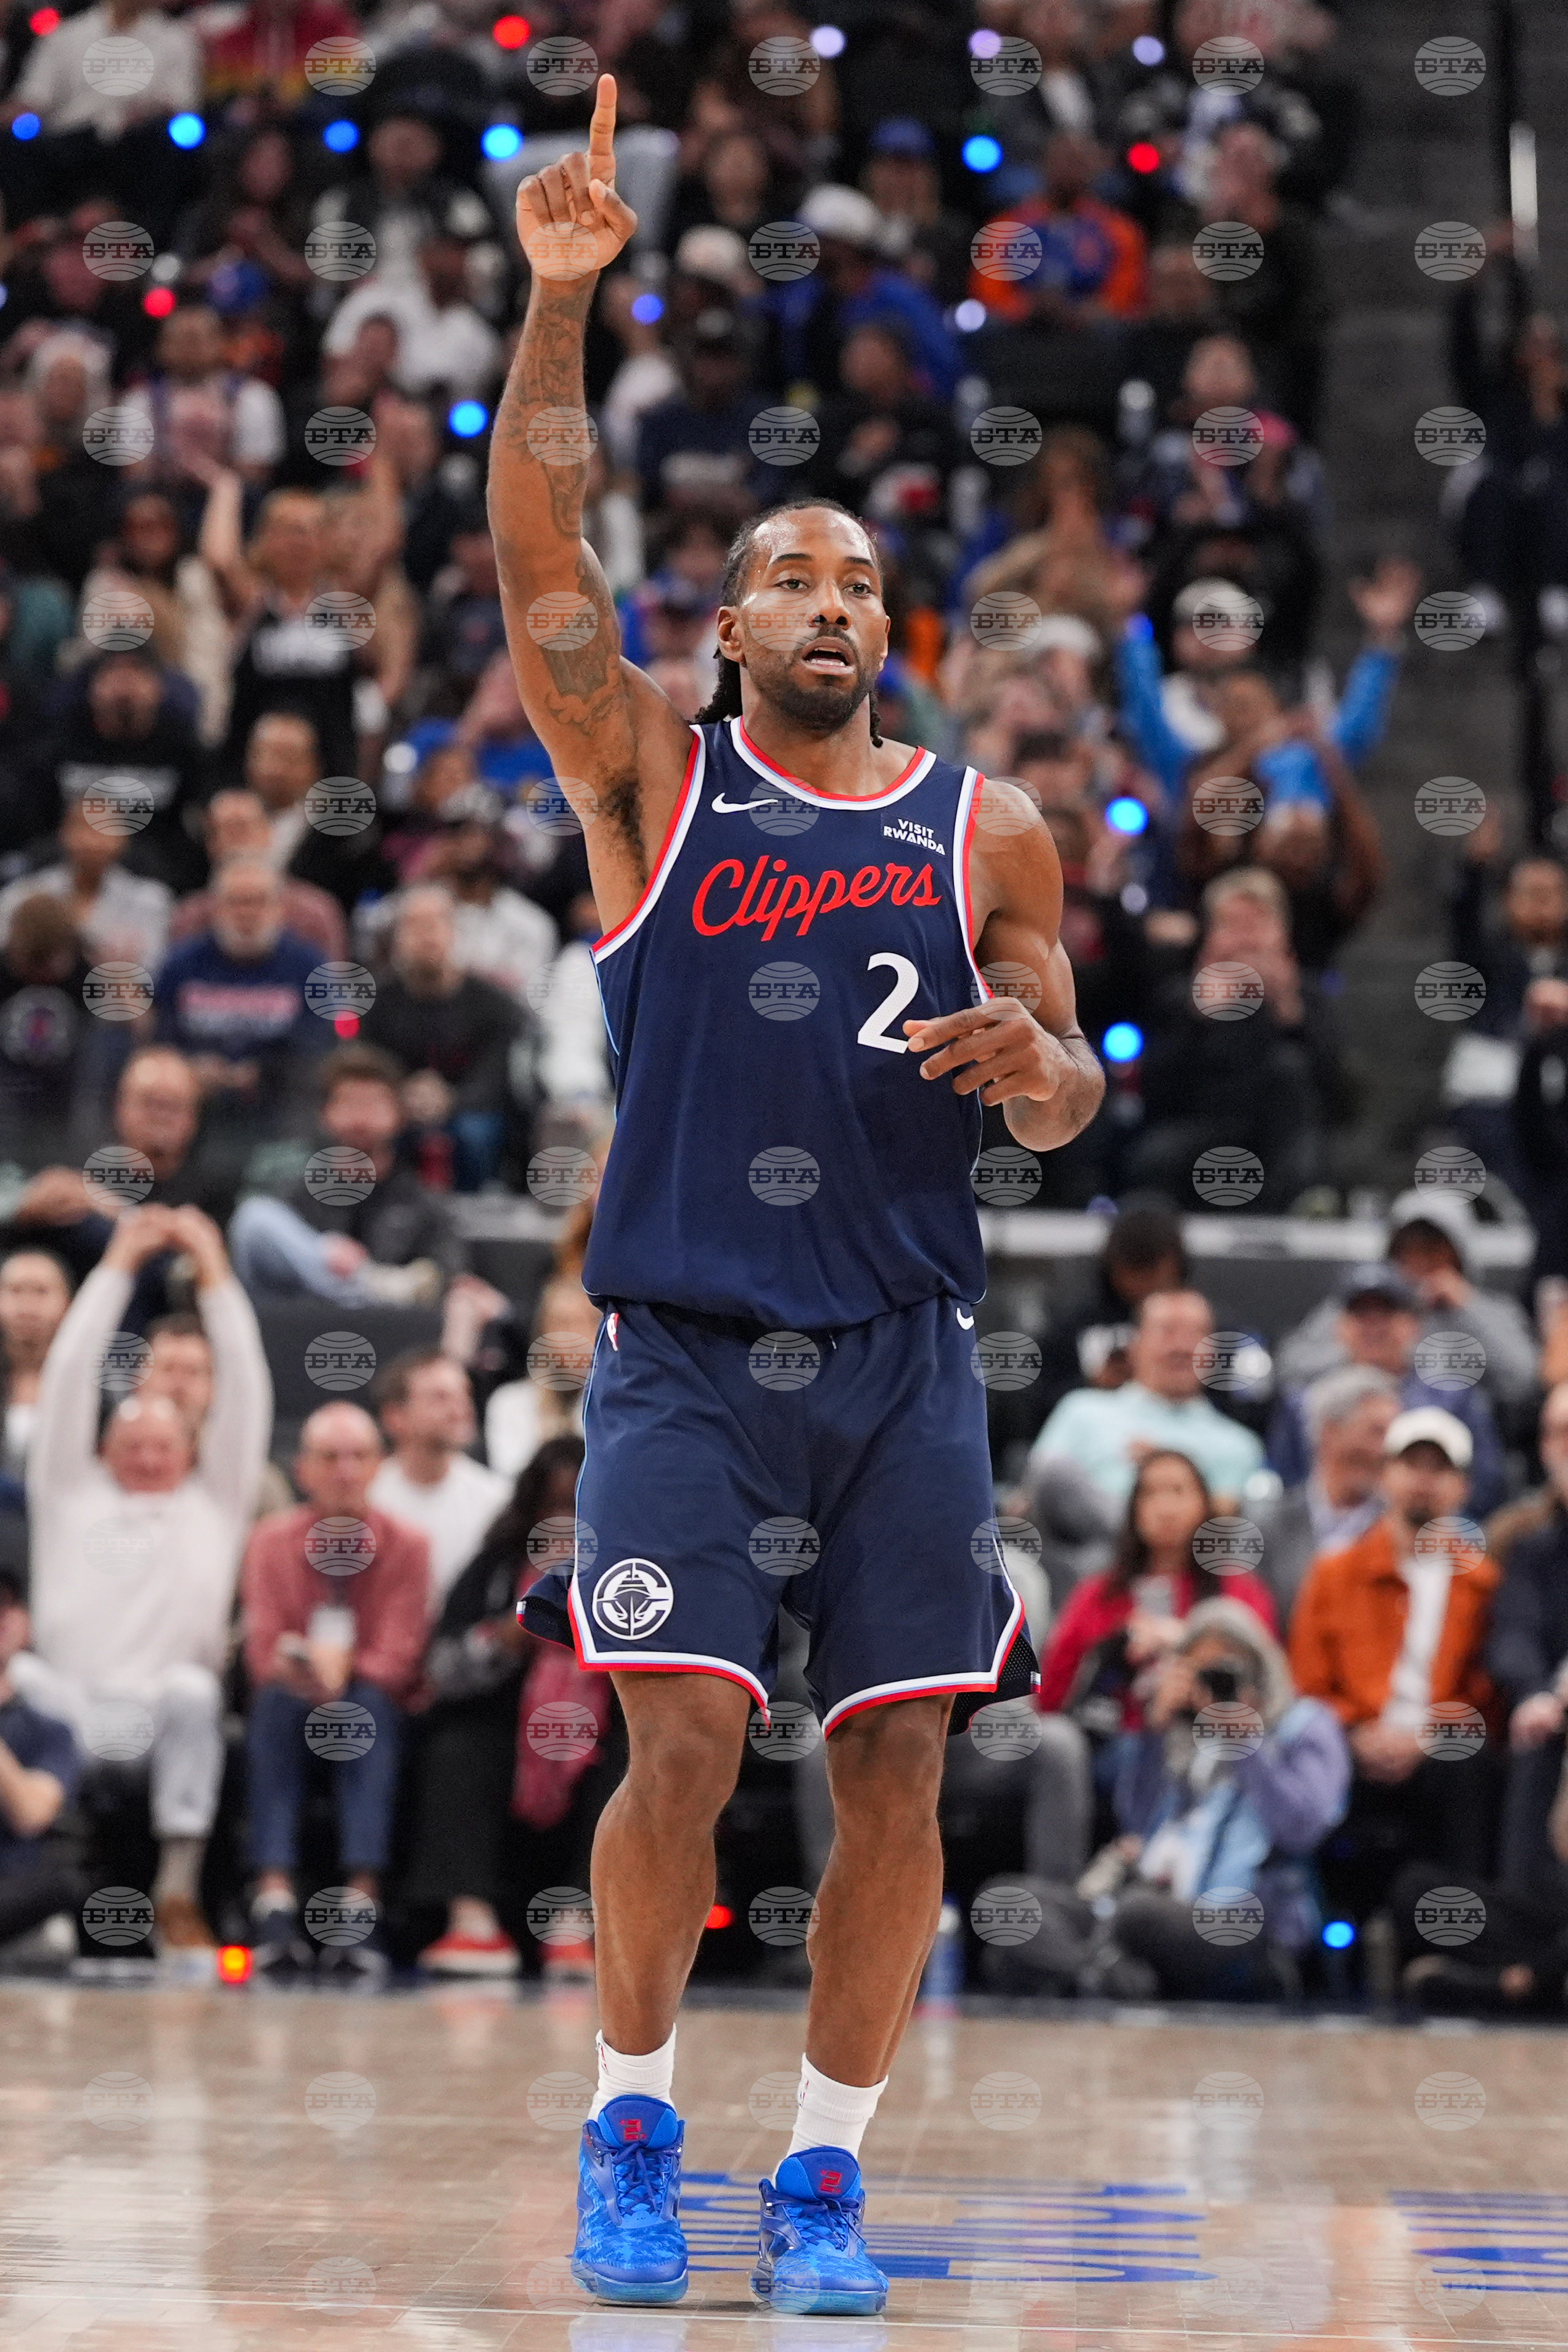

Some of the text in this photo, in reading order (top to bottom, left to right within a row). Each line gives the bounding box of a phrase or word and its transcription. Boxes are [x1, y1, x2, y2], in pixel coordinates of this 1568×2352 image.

[883, 826, 946, 856] RWANDA
[897, 818, 934, 839] VISIT
[692, 855, 942, 942] Clippers
[857, 952, 919, 1054] 2
